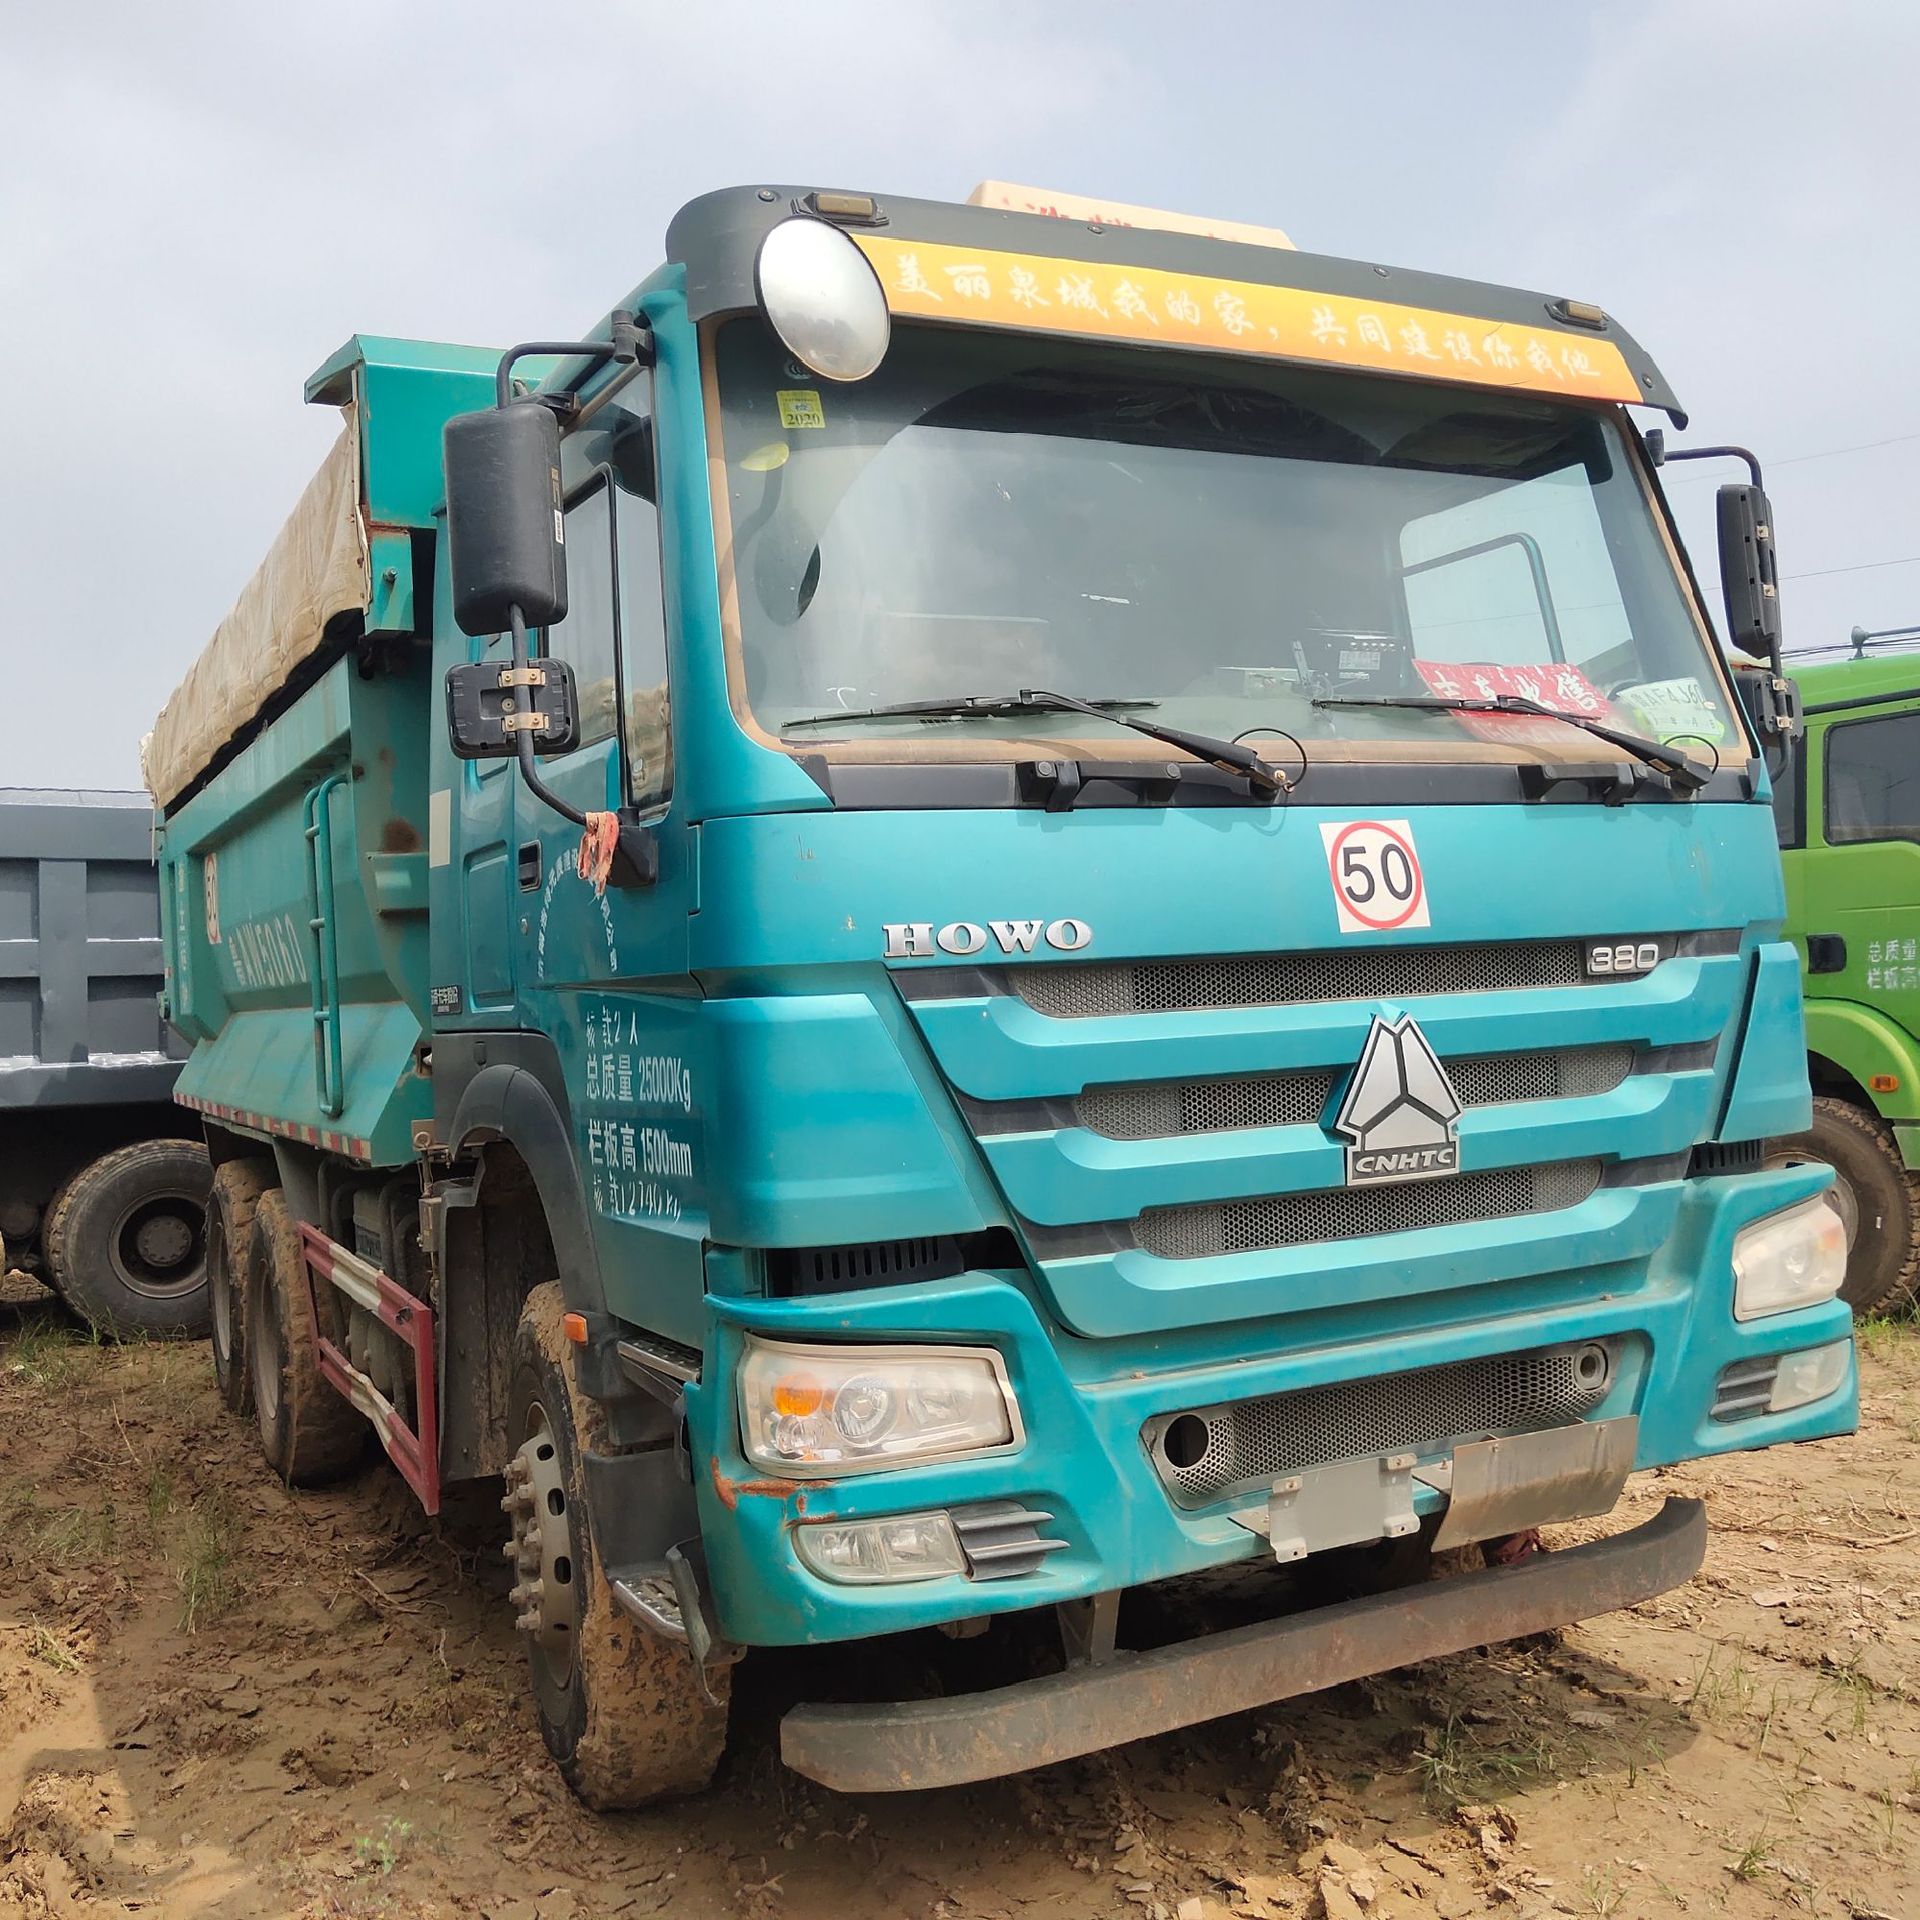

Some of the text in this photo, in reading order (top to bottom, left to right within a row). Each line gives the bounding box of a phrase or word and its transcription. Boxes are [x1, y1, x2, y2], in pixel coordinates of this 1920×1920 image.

[786, 413, 821, 426] 2020
[1342, 842, 1413, 904] 50
[882, 918, 1093, 958] HOWO
[1868, 938, 1917, 963] 总质量
[1590, 943, 1660, 973] 380
[586, 1052, 634, 1102] 总质量
[588, 1117, 693, 1178] 栏板高 1500mm
[1354, 1146, 1455, 1174] CNHTC
